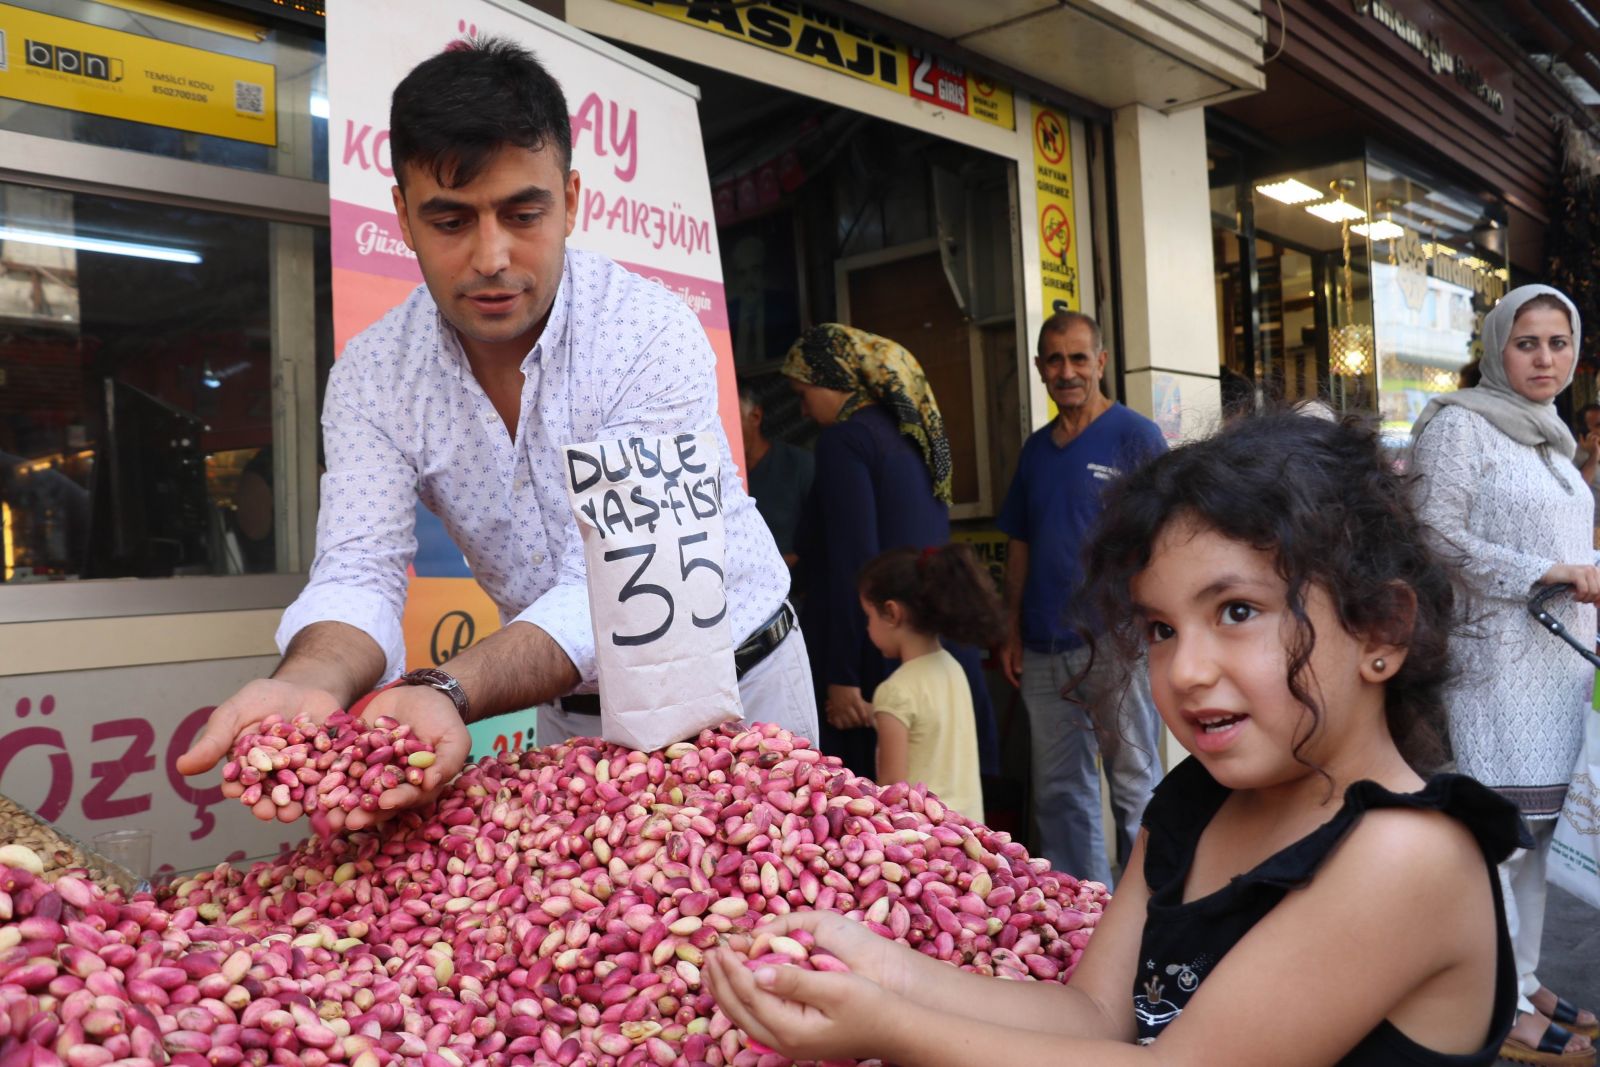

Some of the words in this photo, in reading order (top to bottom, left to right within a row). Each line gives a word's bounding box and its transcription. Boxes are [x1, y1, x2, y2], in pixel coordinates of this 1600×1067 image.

[27, 39, 108, 79] bpn
[640, 0, 898, 85] ASAJI
[188, 80, 215, 92] KODU
[566, 433, 707, 495] DUBLE
[603, 531, 727, 647] 35
